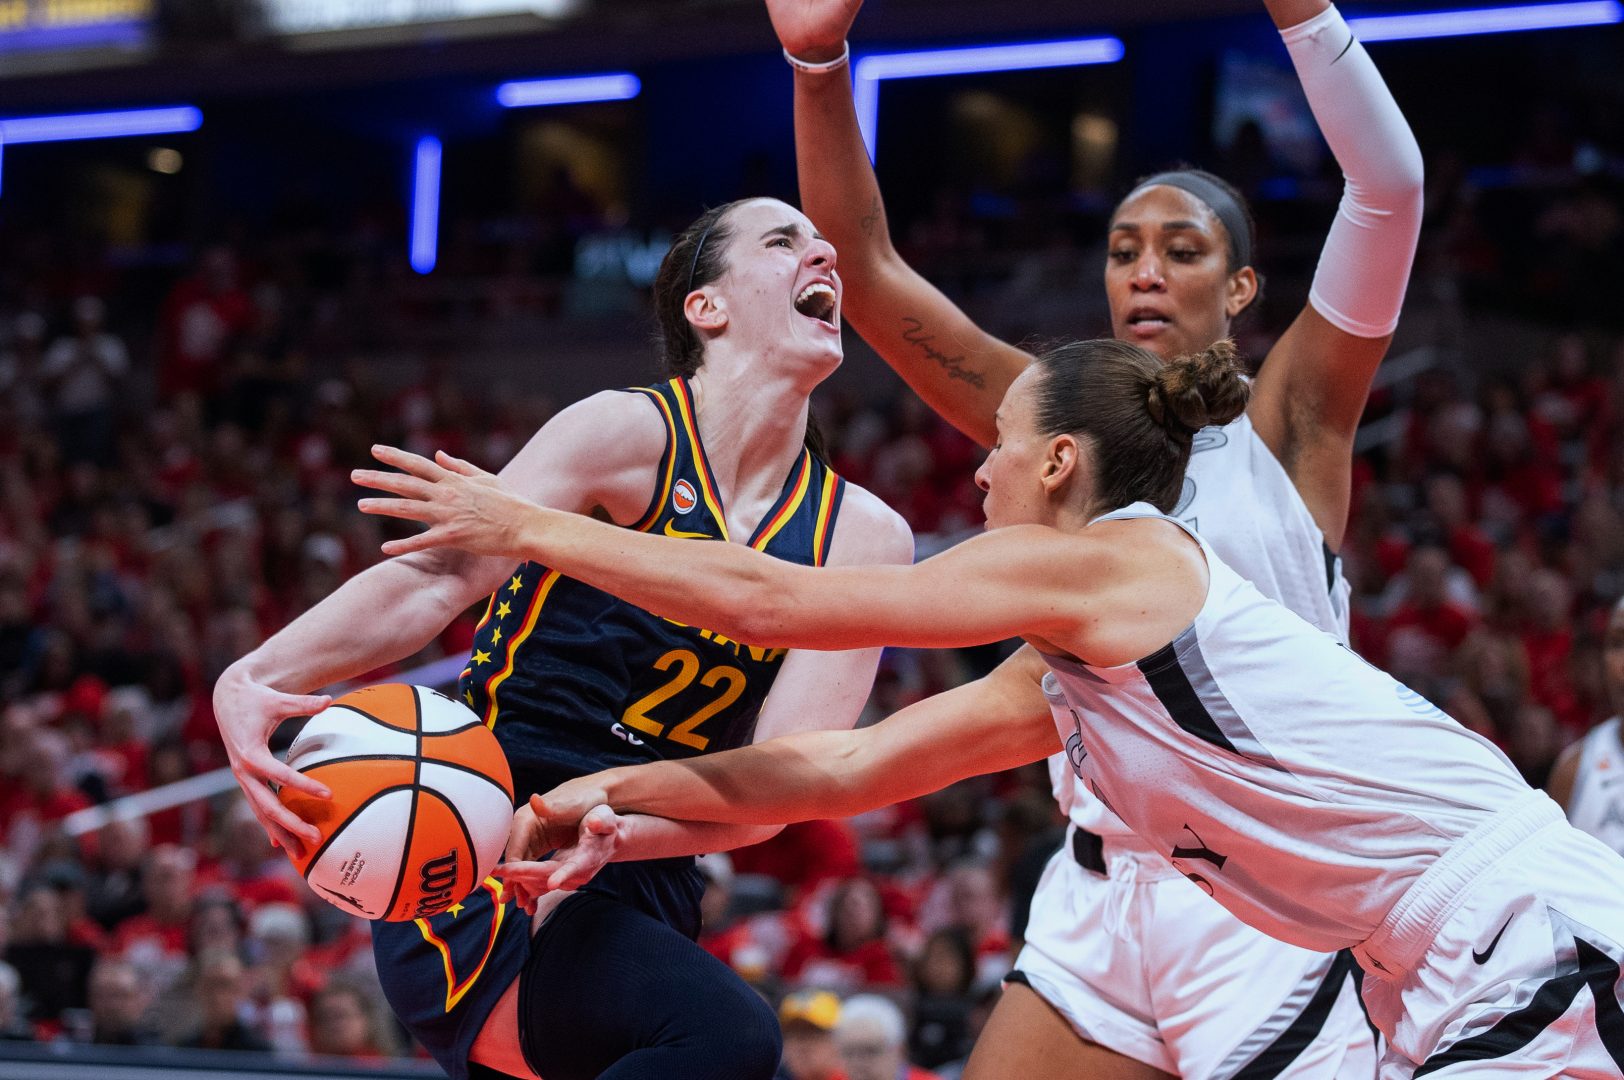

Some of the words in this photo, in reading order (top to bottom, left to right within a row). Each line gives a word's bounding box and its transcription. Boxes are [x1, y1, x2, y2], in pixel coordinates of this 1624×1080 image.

[621, 649, 747, 751] 22
[347, 859, 366, 887] OFFICIAL
[350, 851, 361, 872] GAME
[340, 871, 351, 886] BALL
